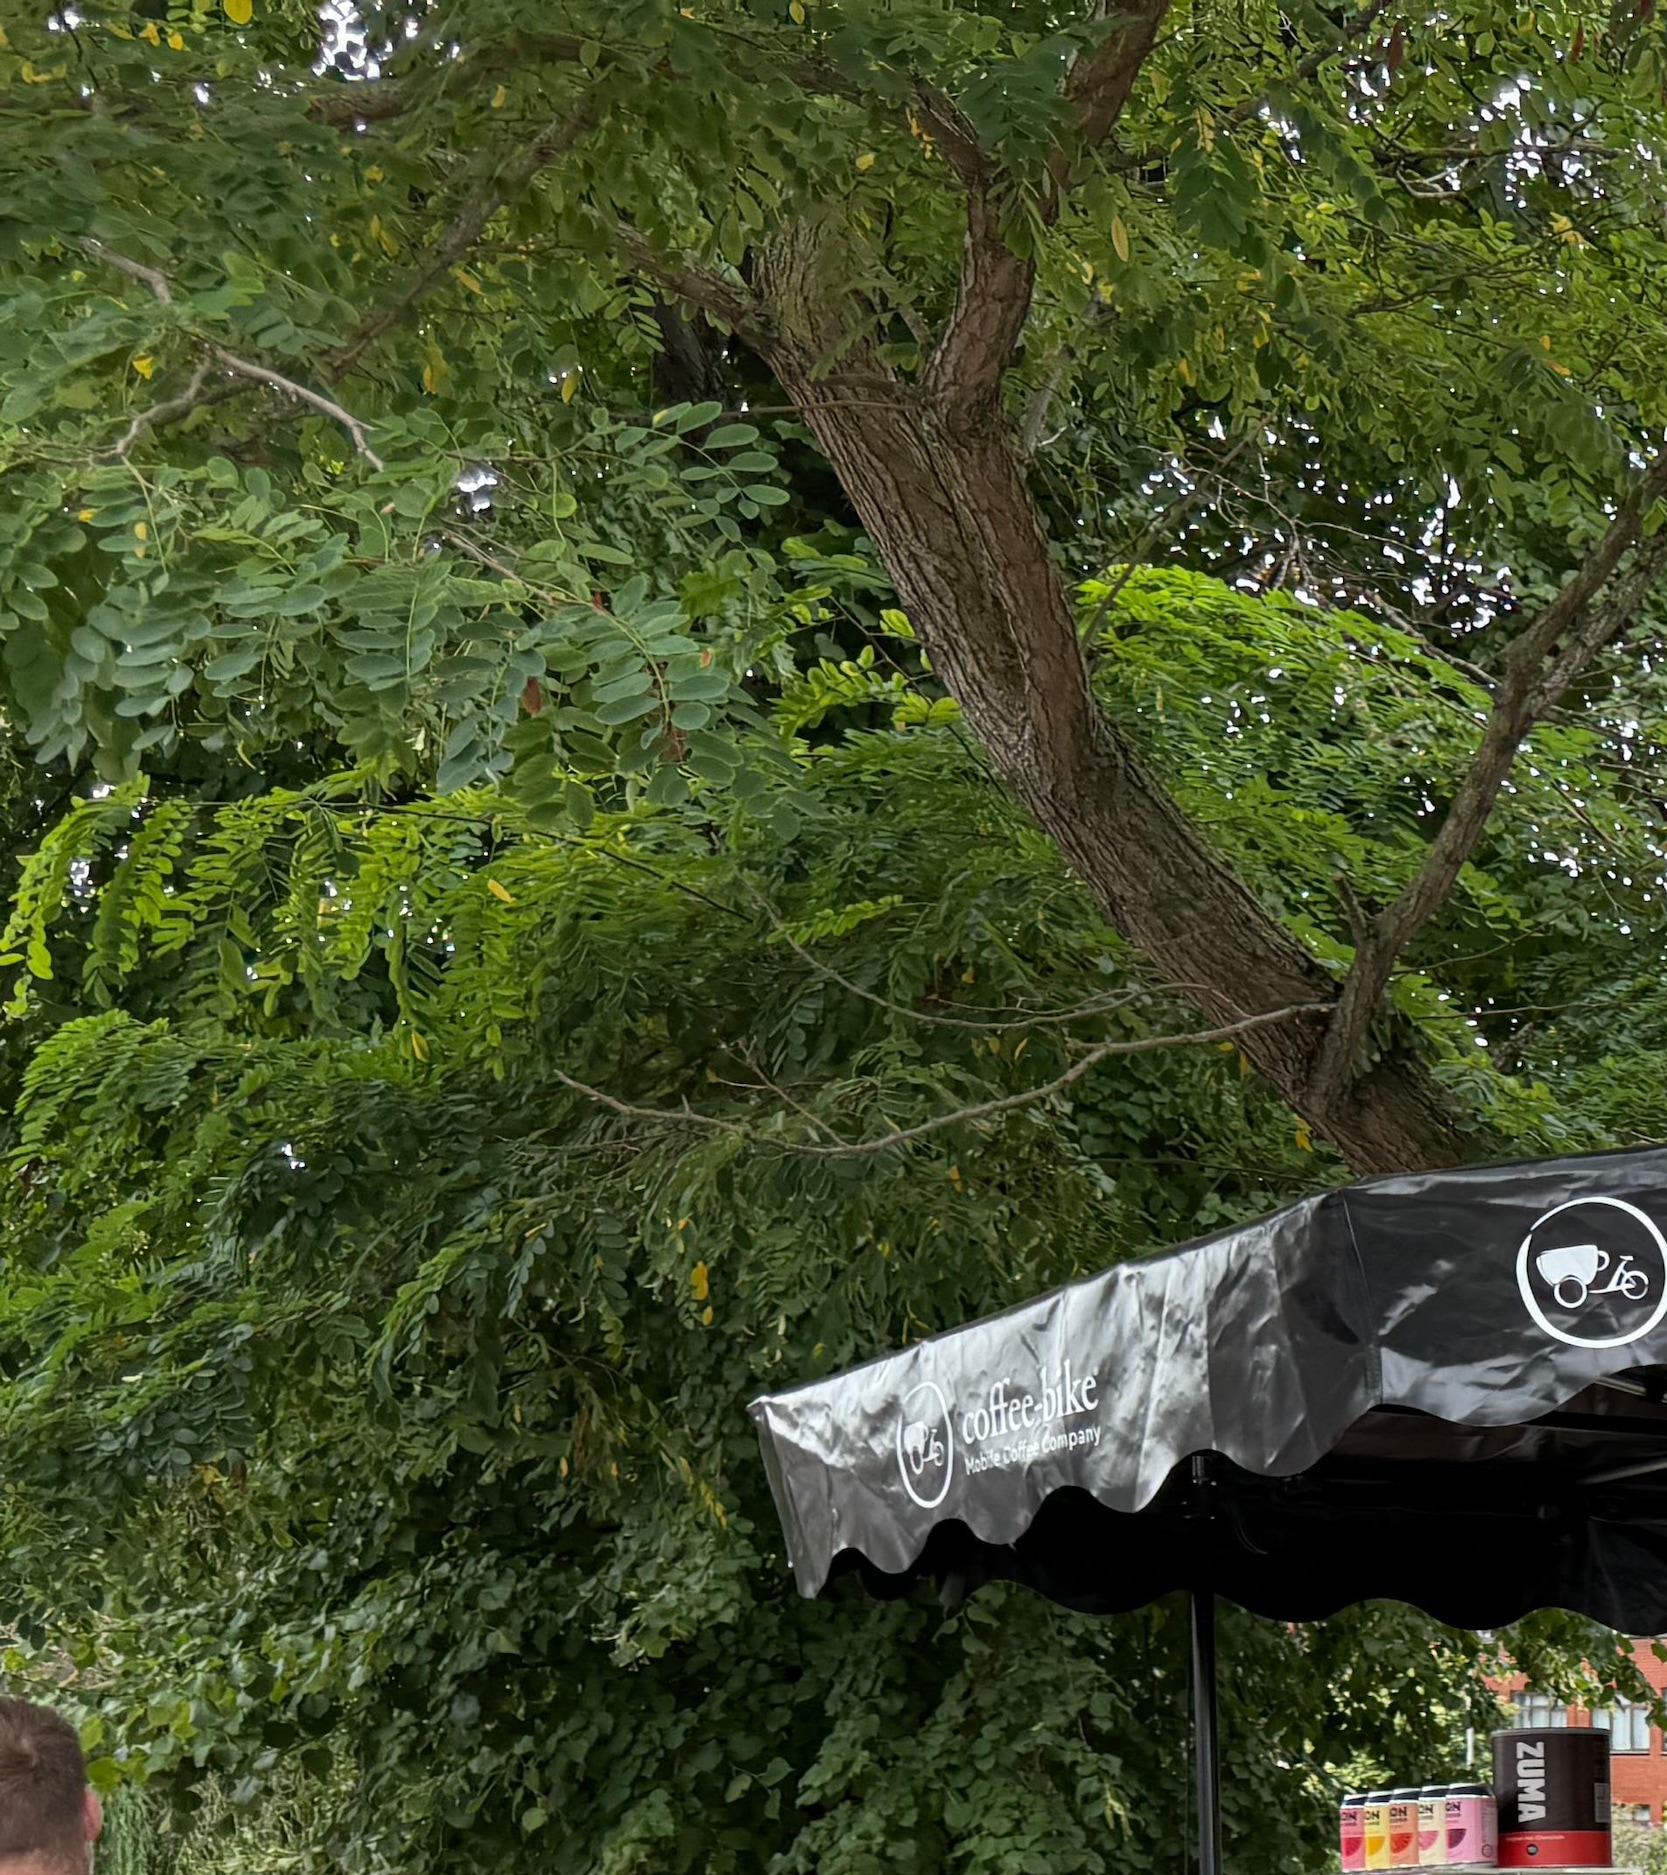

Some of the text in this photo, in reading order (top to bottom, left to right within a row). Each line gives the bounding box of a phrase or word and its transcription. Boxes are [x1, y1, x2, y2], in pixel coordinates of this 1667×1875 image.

[962, 1358, 1100, 1444] coffee-bike
[964, 1424, 1101, 1476] Mobile Coffee Company
[1516, 1741, 1546, 1823] ZUMA
